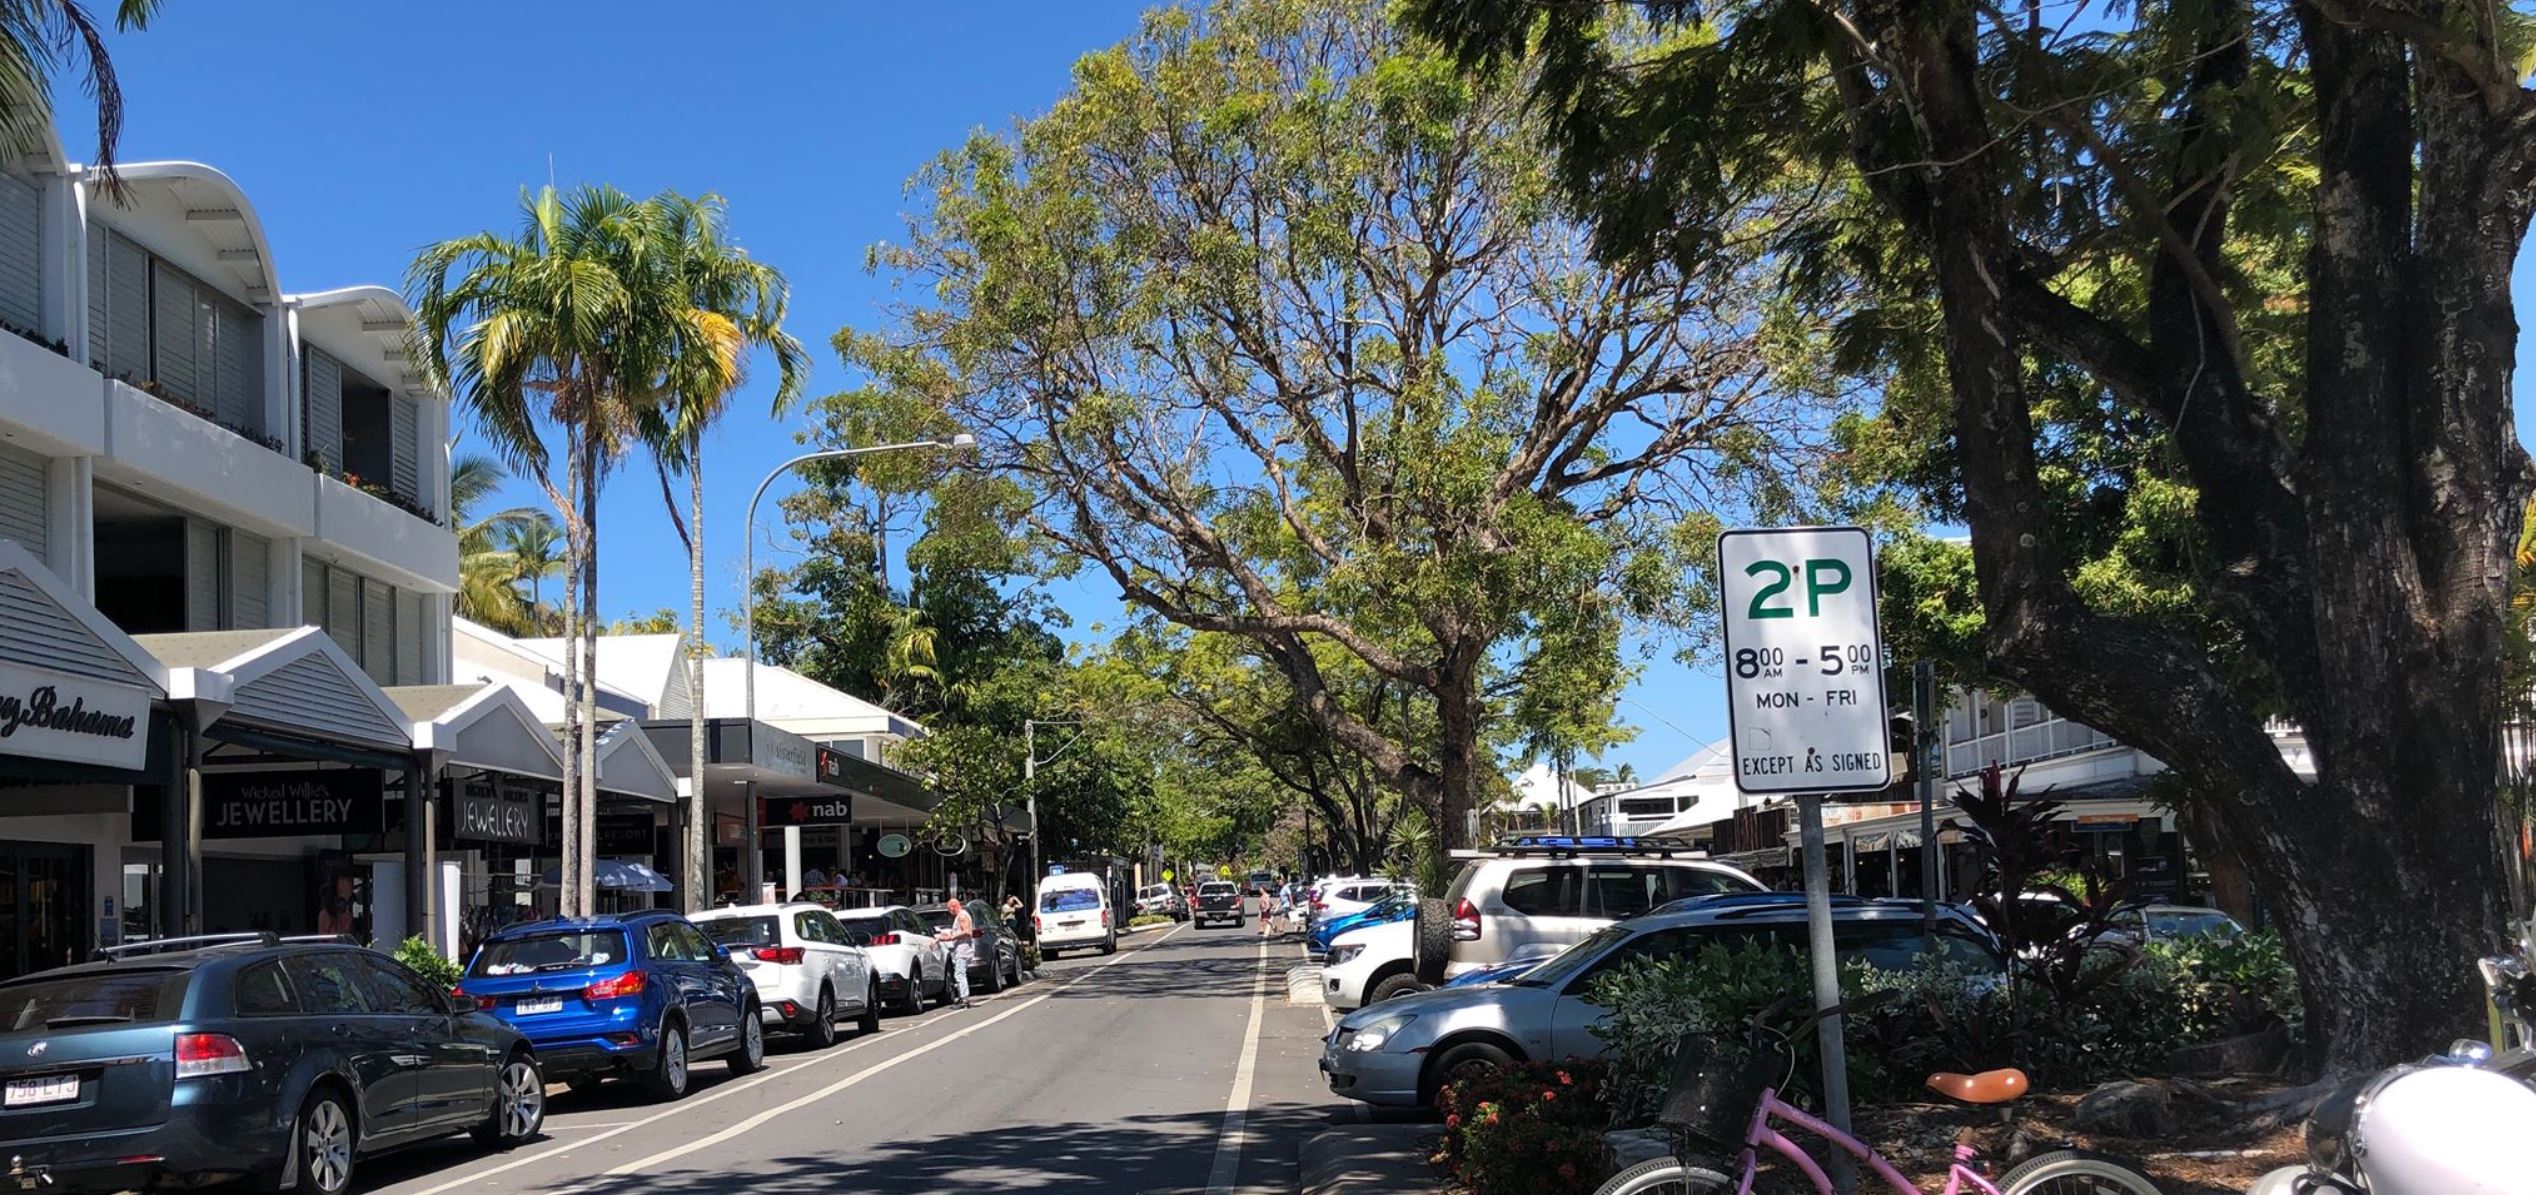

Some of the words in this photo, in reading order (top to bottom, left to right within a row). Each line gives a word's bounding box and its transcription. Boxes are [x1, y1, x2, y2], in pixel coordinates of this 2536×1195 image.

[1744, 558, 1852, 619] 2P
[22, 685, 135, 739] Bahama
[1756, 691, 1799, 709] MON
[1826, 690, 1857, 706] FRI
[1743, 756, 1794, 776] EXCEPT
[1805, 754, 1823, 773] AS
[1832, 752, 1881, 772] SIGNED
[216, 798, 352, 826] JEWELLERY
[461, 801, 529, 839] JEWELLERY
[812, 801, 848, 817] nab
